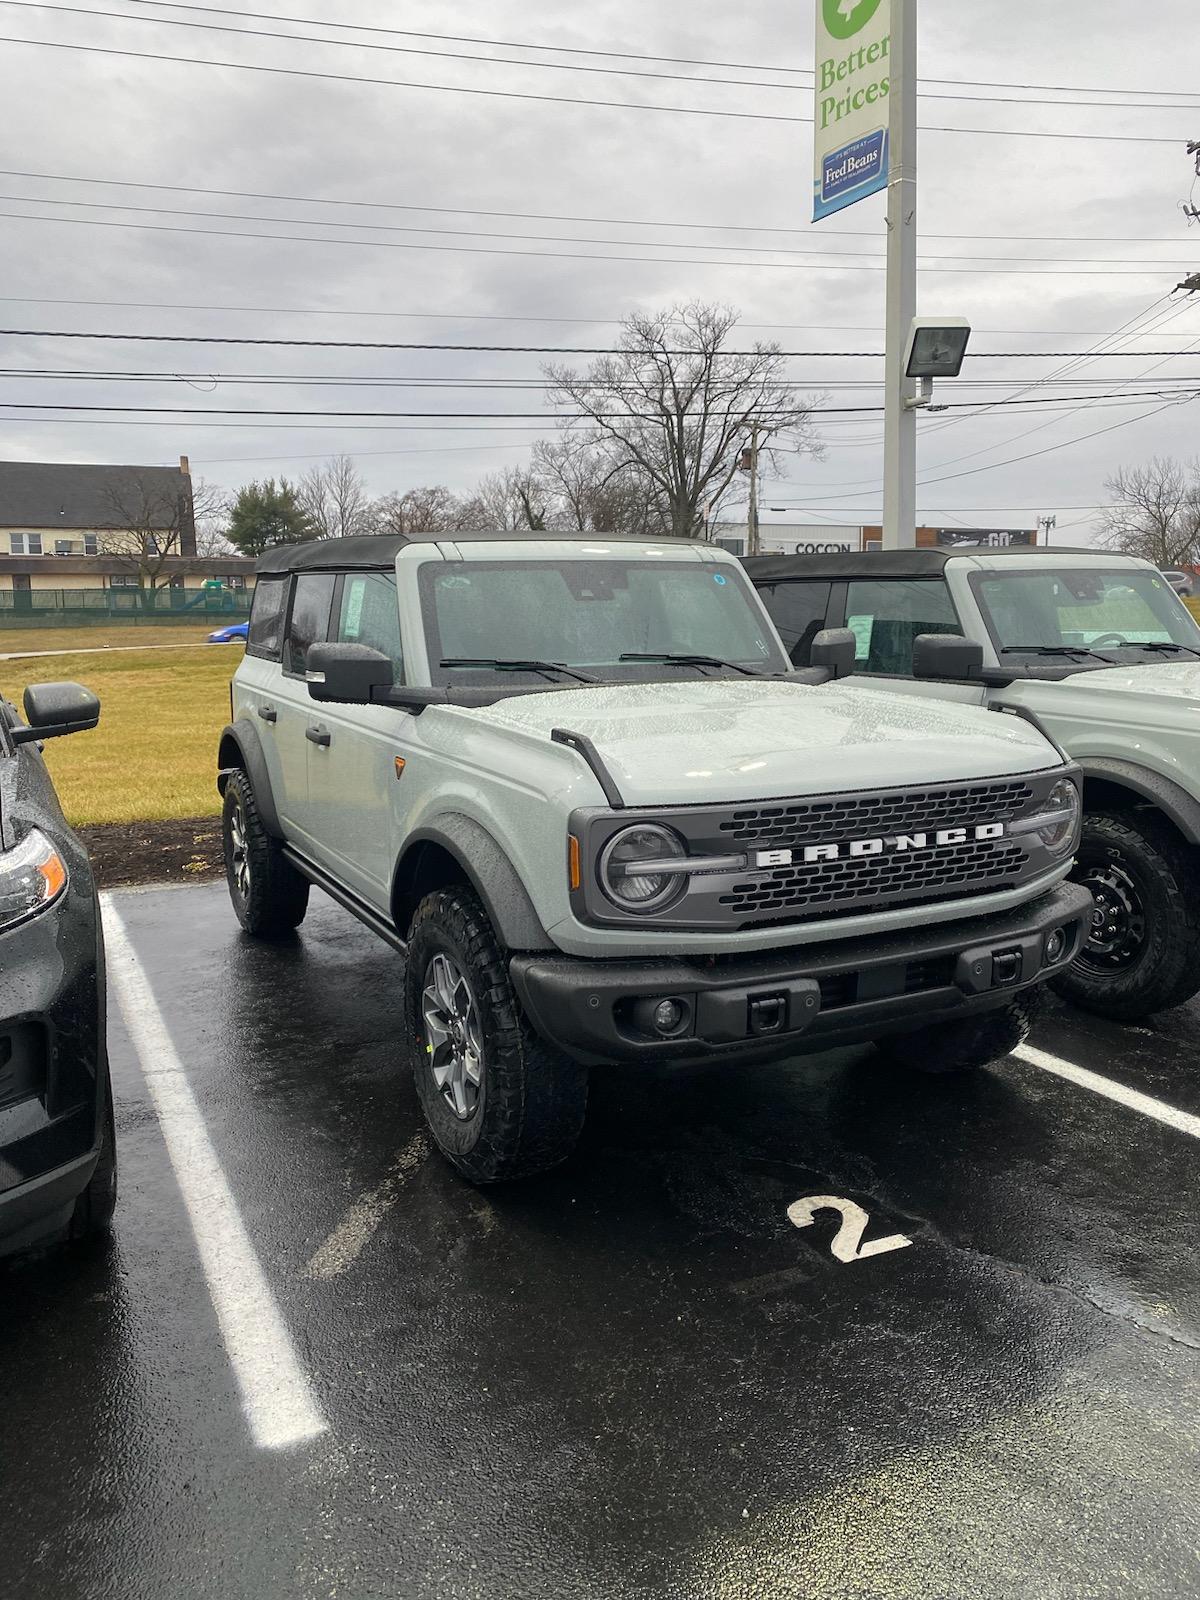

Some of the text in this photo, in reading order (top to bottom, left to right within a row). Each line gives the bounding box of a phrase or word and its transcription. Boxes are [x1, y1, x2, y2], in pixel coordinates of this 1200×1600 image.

[819, 34, 890, 93] Better
[820, 77, 890, 130] Prices
[825, 160, 847, 184] Fred
[847, 149, 878, 172] Beans
[756, 822, 1004, 868] BRONCO
[787, 1195, 914, 1264] 2
